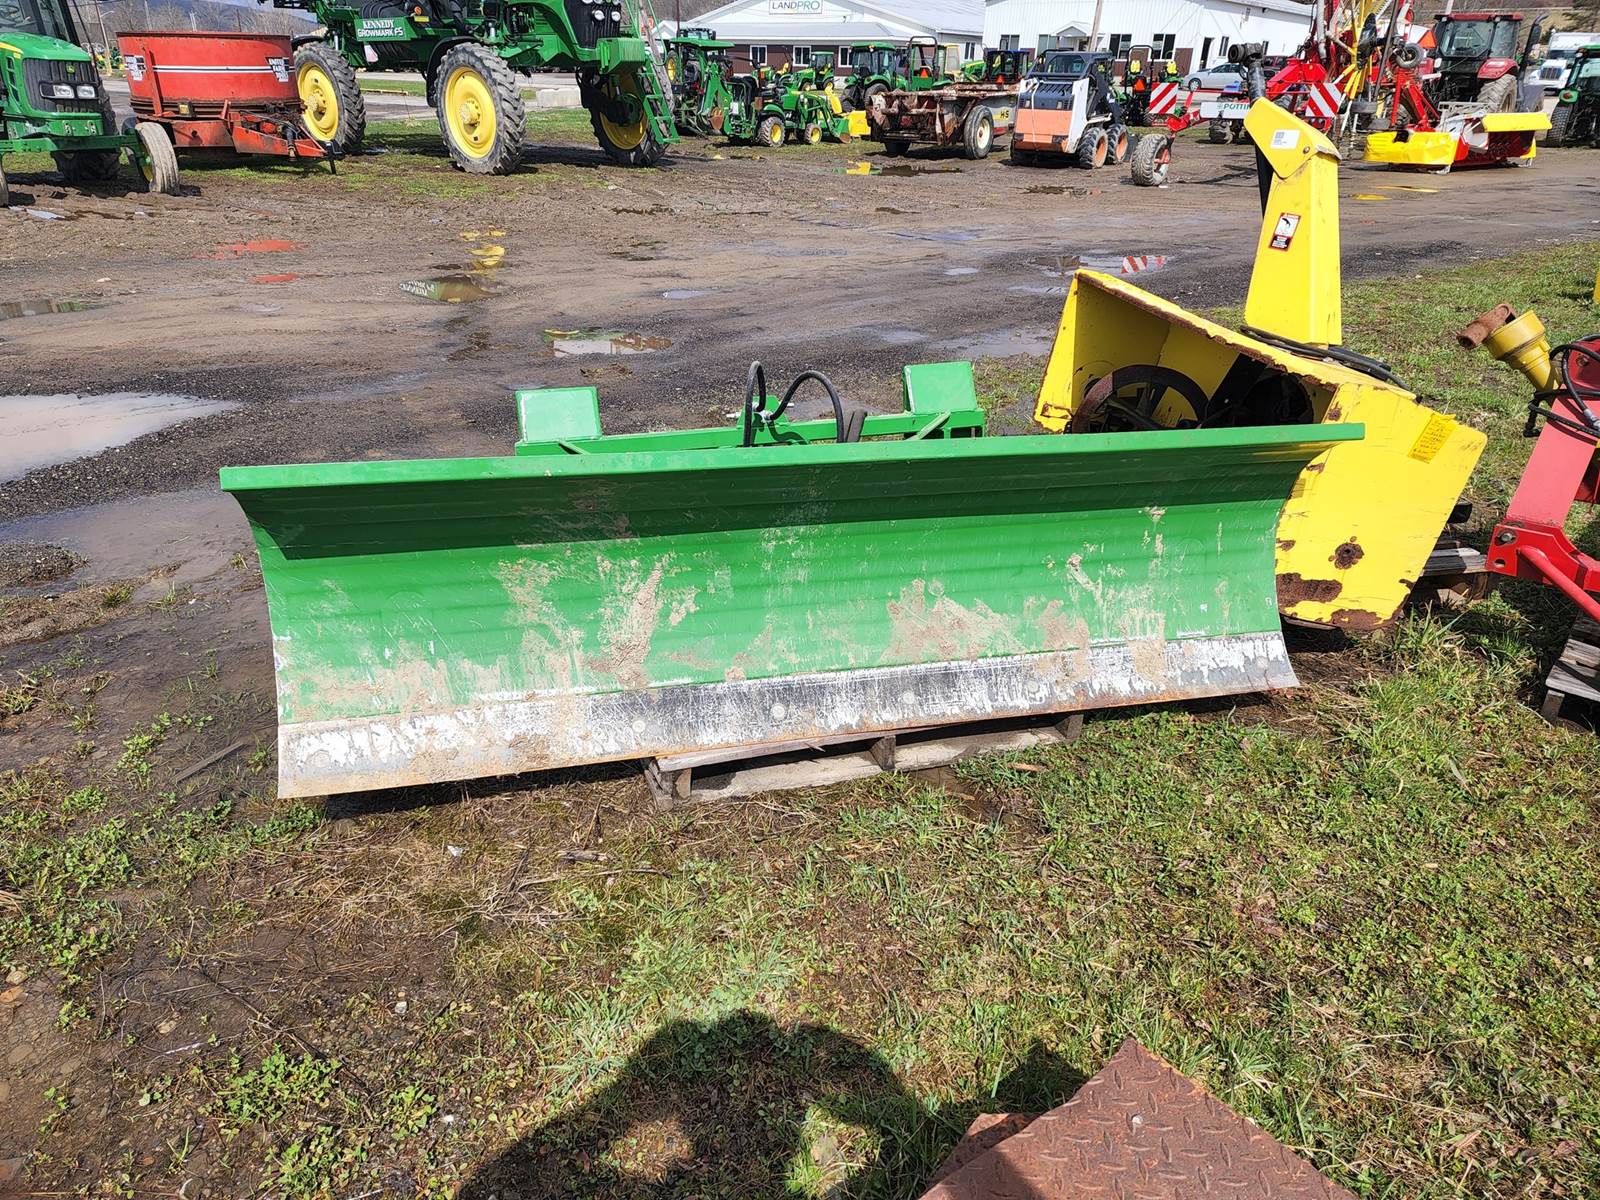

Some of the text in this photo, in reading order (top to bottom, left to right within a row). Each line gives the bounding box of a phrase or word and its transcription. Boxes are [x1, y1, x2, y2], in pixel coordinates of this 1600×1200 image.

[772, 1, 820, 10] LANDPRO
[363, 20, 394, 29] KENNEDY
[358, 27, 404, 37] GROWMARK FS
